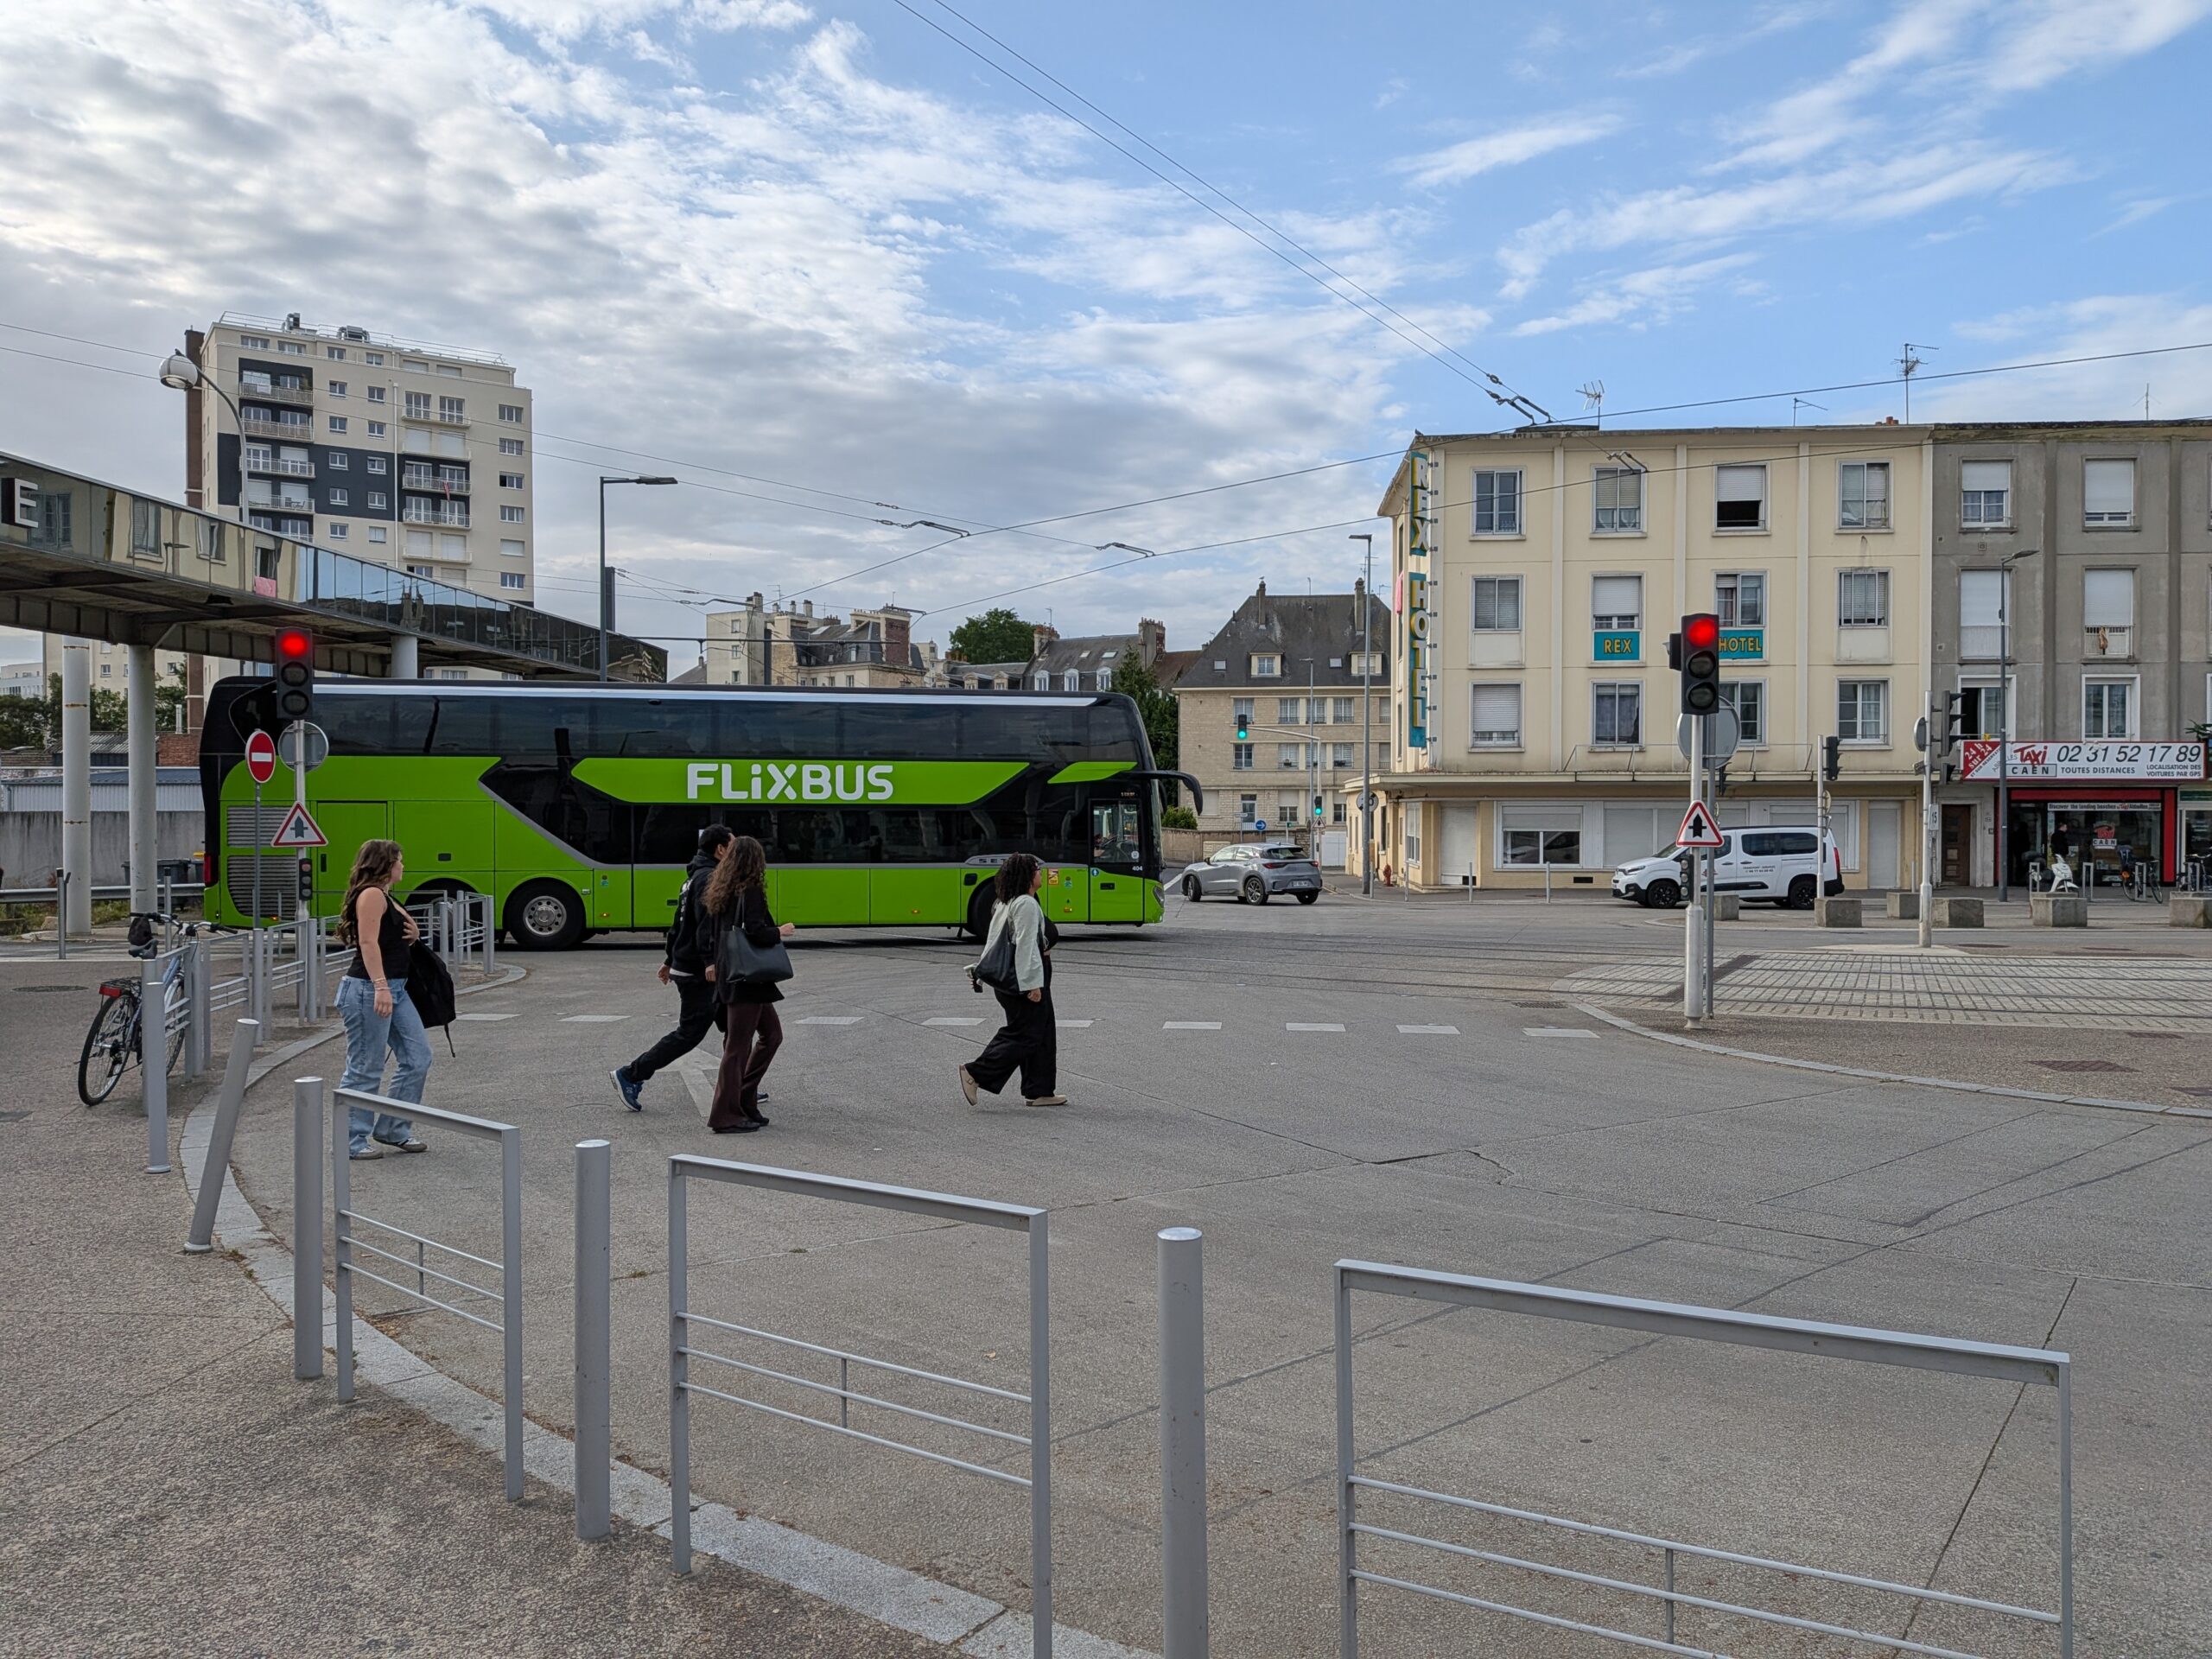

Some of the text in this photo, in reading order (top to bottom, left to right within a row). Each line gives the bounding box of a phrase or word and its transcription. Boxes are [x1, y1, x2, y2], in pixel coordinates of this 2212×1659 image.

[1410, 457, 1429, 728] REX HOTEL
[1604, 637, 1763, 654] REX HOTEL
[1965, 747, 1977, 760] 24
[1968, 744, 1993, 770] sur 24
[2056, 745, 2202, 763] 02 31 52 17 89
[2012, 766, 2050, 775] CAEN
